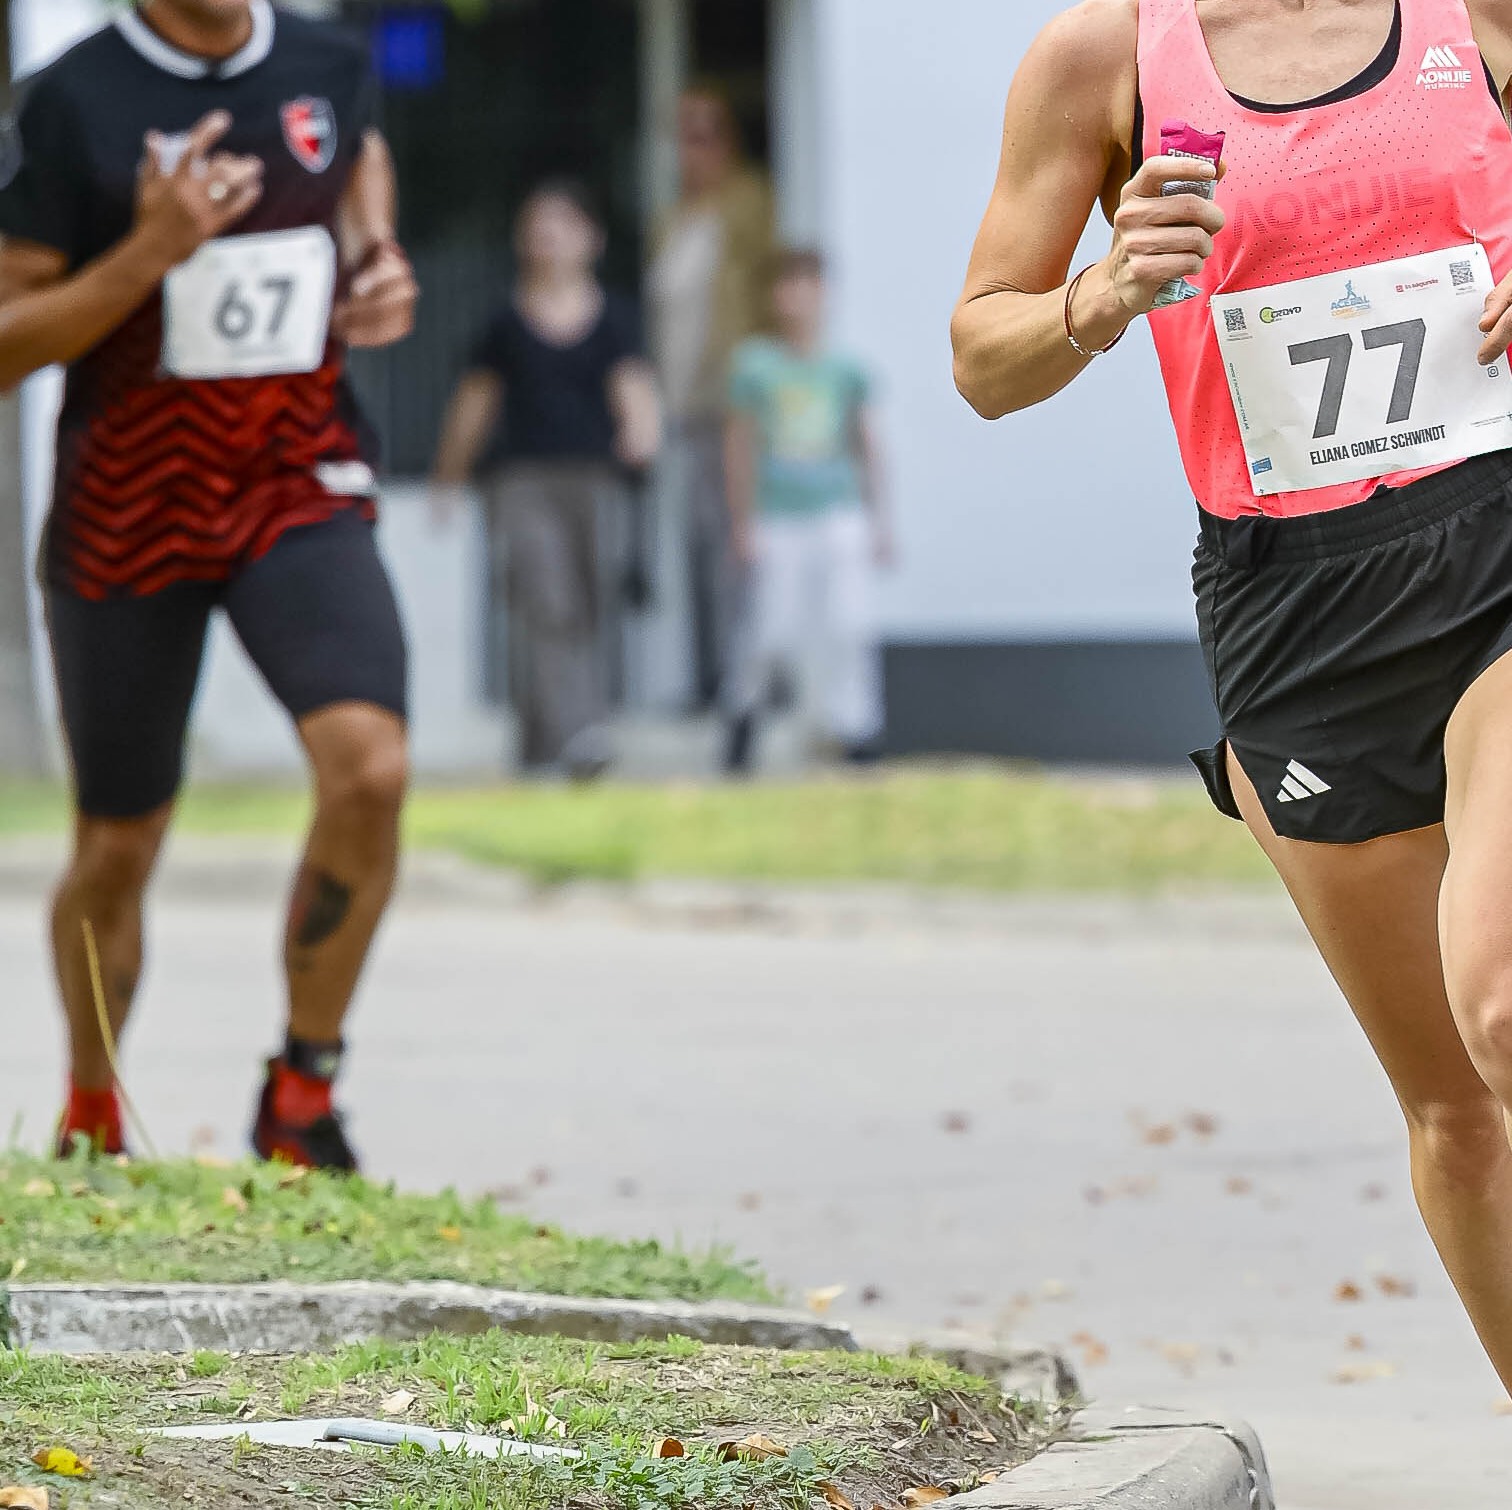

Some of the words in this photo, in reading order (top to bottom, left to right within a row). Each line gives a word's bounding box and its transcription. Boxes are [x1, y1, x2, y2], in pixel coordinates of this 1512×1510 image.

[214, 274, 295, 341] 67
[1288, 318, 1426, 439] 77
[1309, 445, 1350, 465] ELIANA
[1350, 436, 1389, 458] GOMEZ
[1390, 424, 1446, 450] SCHWINDT
